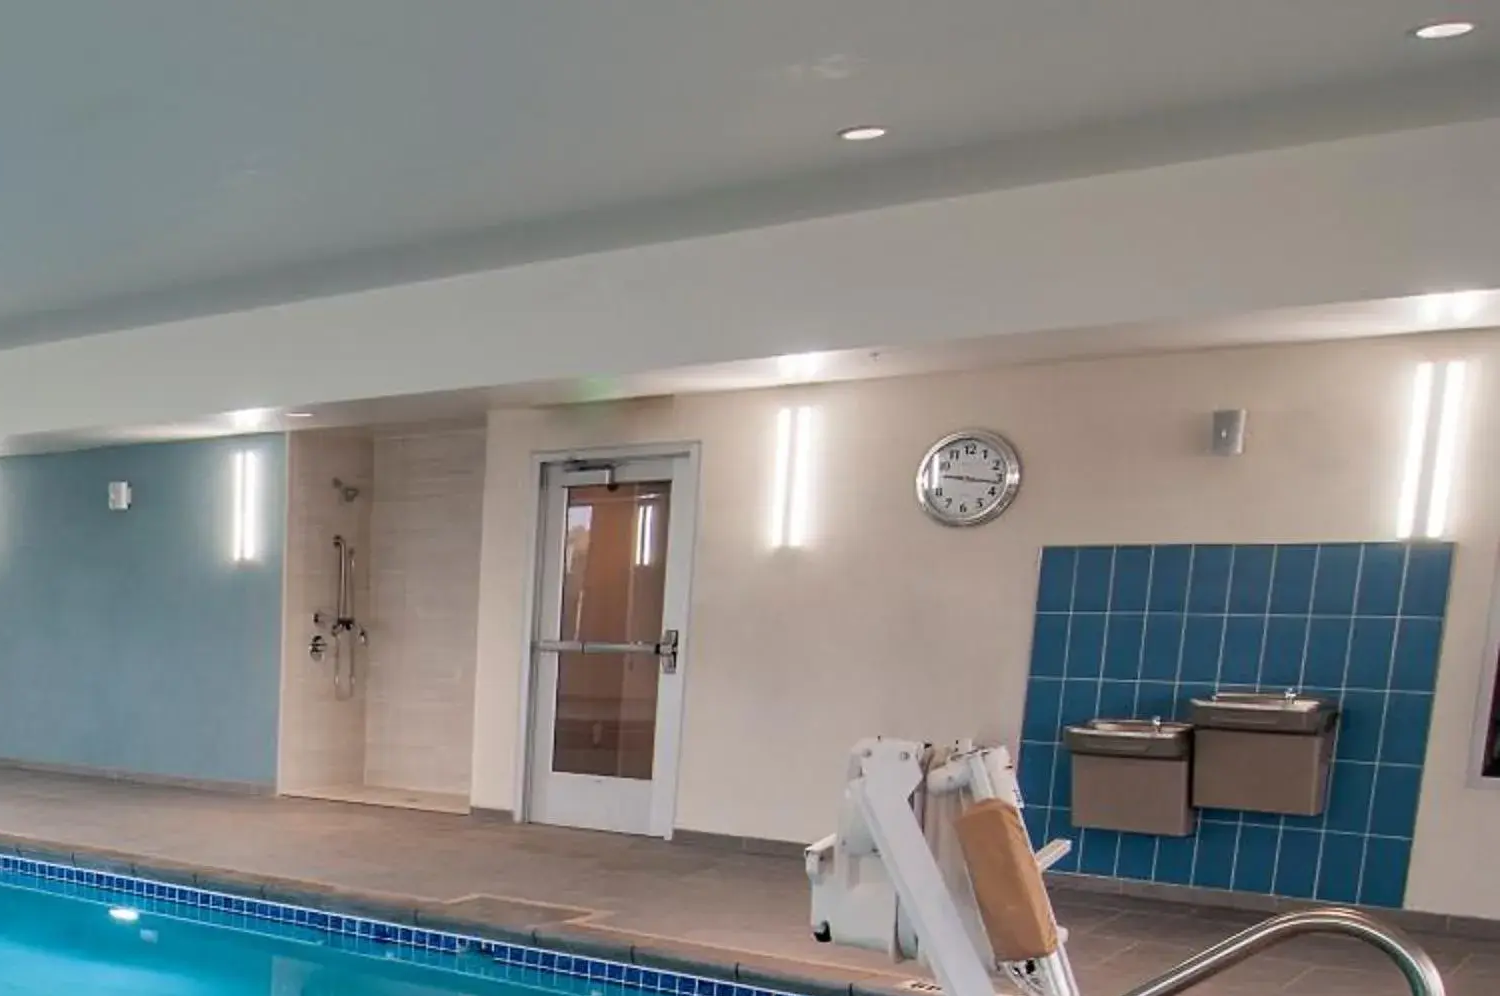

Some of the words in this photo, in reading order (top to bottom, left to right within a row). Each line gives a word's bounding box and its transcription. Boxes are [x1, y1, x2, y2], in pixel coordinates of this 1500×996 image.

[964, 443, 977, 455] 12
[982, 449, 989, 459] 1
[992, 459, 1001, 470] 2
[988, 486, 996, 496] 4
[945, 498, 953, 508] 7
[960, 503, 967, 513] 6
[977, 498, 984, 508] 5
